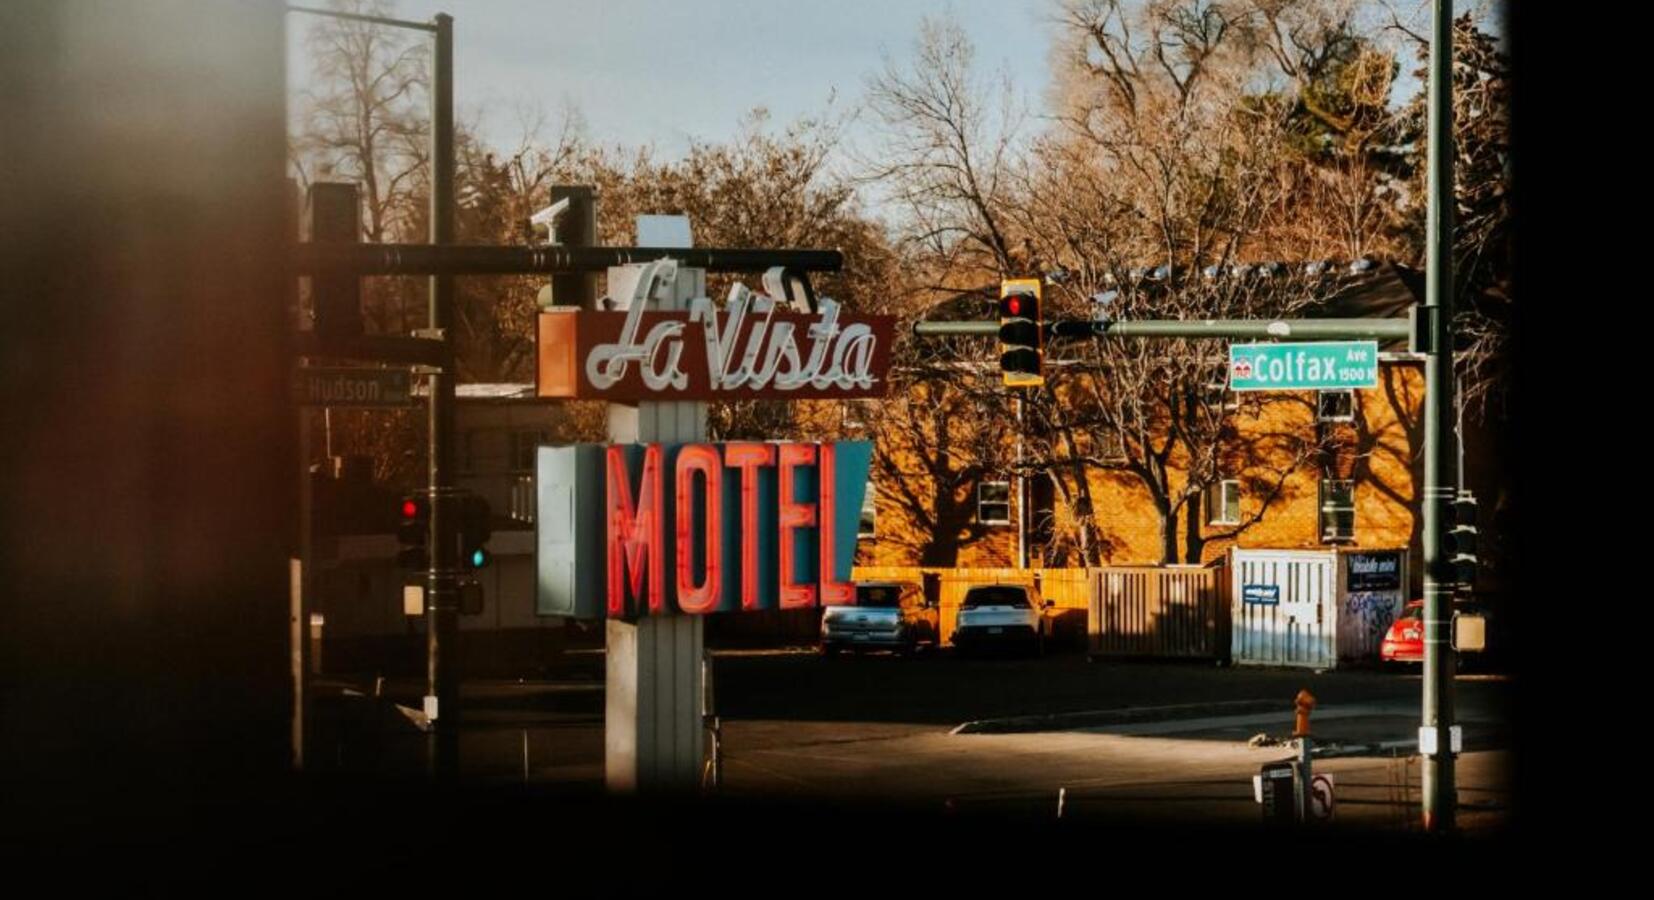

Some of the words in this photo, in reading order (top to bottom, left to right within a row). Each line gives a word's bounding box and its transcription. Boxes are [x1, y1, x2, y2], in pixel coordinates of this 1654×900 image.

[586, 257, 688, 392] La
[687, 282, 881, 391] Vista
[1254, 351, 1336, 382] Colfax
[1346, 349, 1368, 363] Ave
[309, 373, 379, 401] Hudson
[1339, 367, 1365, 382] 1500
[1366, 366, 1376, 380] N
[606, 440, 857, 615] MOTEL
